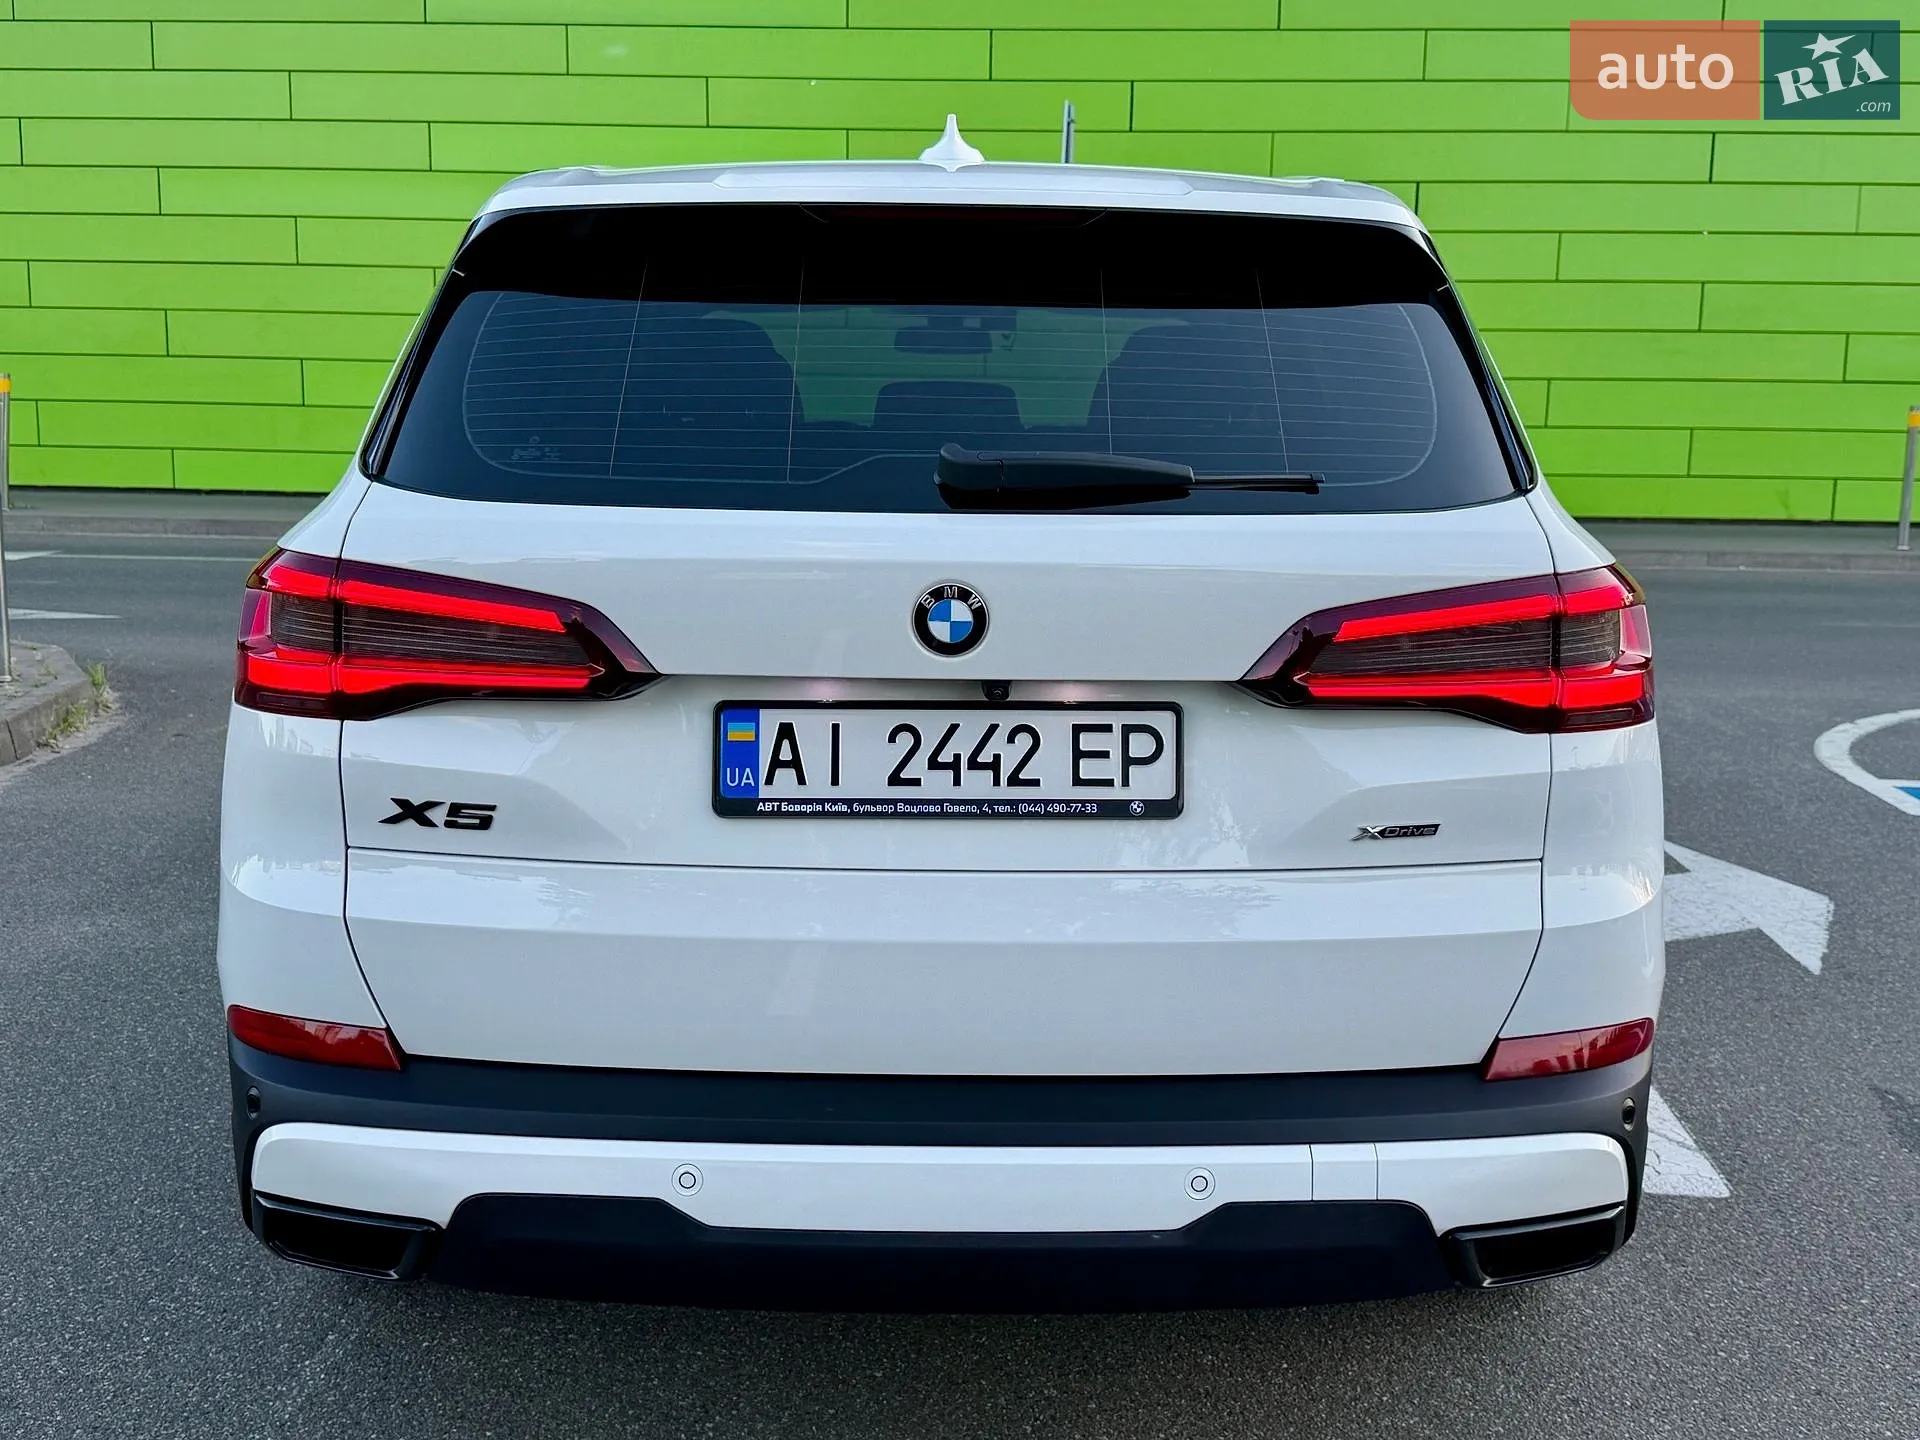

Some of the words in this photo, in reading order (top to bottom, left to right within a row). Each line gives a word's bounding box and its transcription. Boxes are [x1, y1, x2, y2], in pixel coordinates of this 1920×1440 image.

[920, 585, 982, 610] BMW
[887, 722, 1042, 787] 2442
[1071, 723, 1165, 787] EP
[726, 767, 755, 787] UA
[378, 797, 497, 831] X5
[756, 802, 780, 812] АВТ
[852, 802, 895, 814] бульвар
[896, 803, 941, 814] Вацлава
[982, 803, 992, 815] 4,
[1018, 803, 1045, 815] (044)
[1046, 803, 1098, 814] 490-77-33
